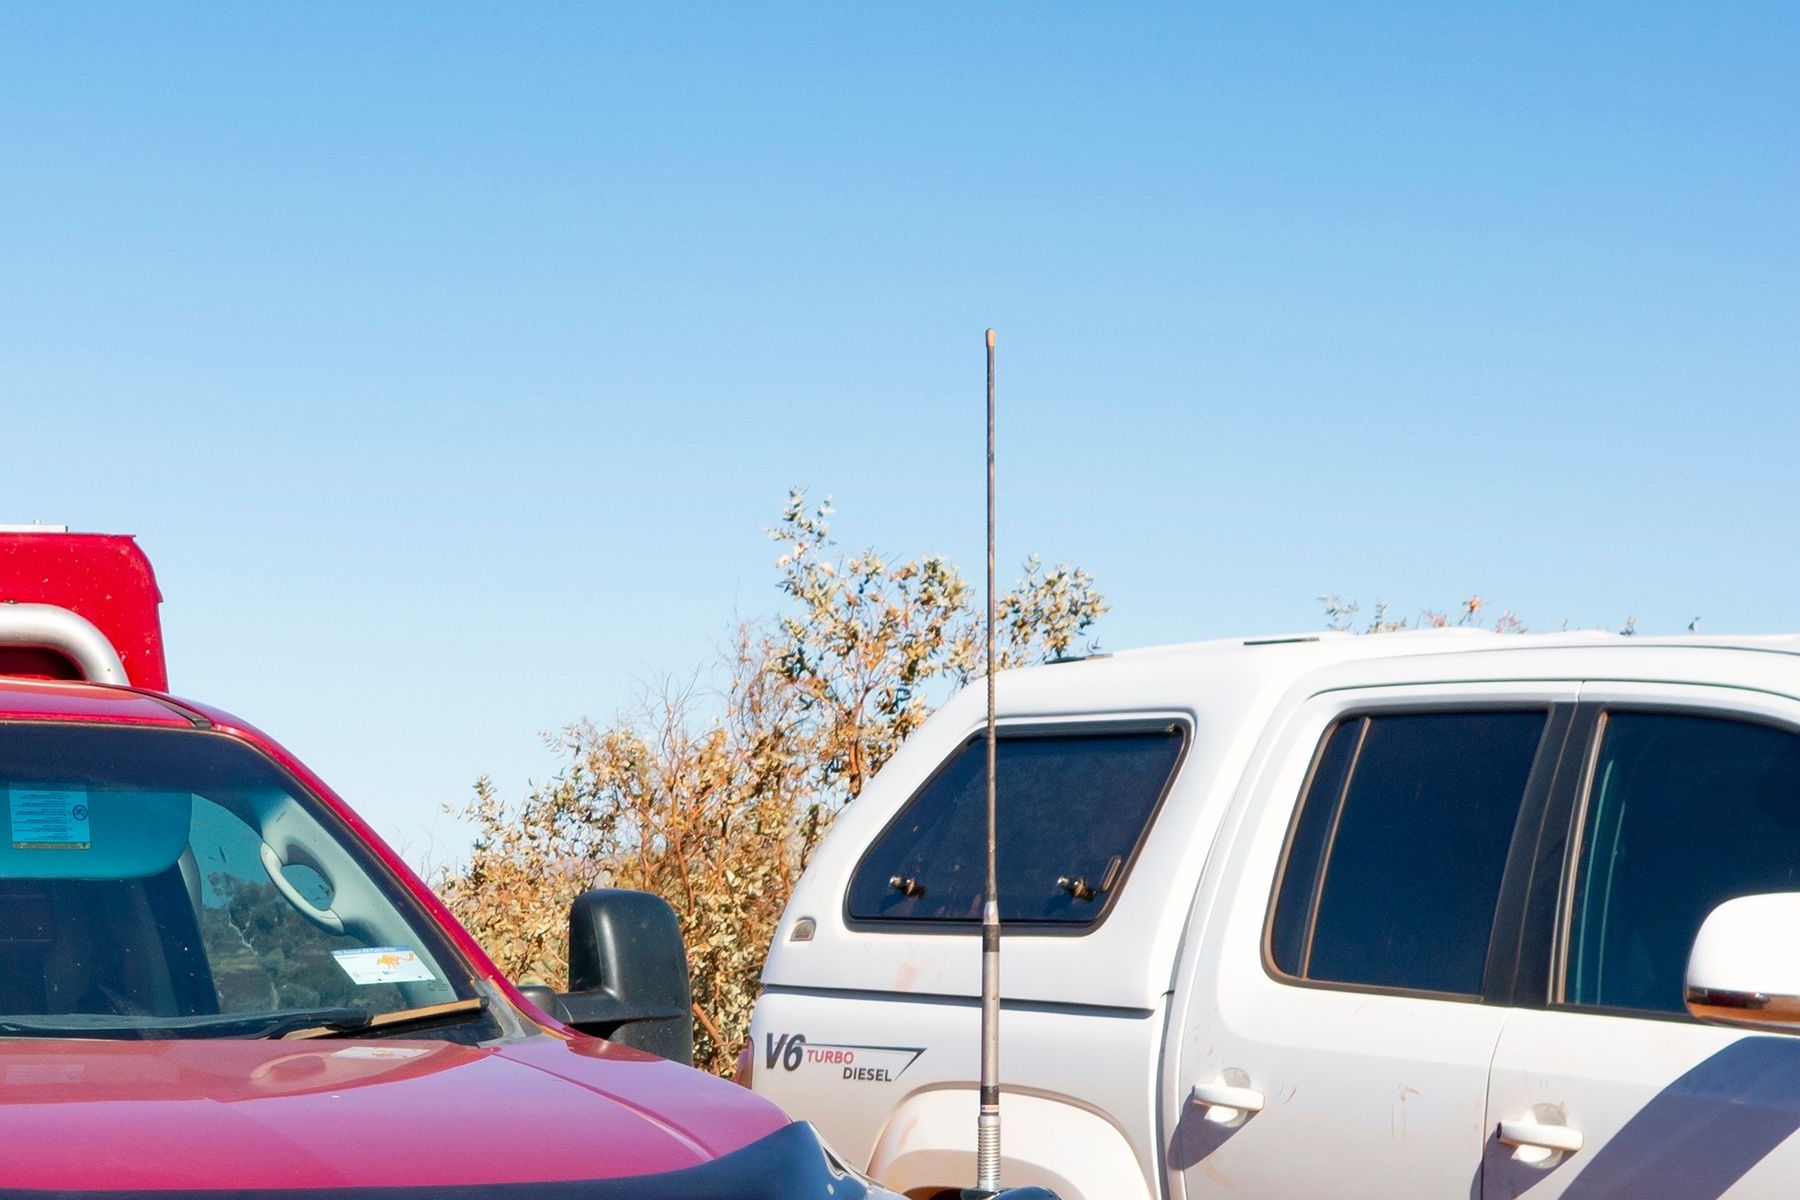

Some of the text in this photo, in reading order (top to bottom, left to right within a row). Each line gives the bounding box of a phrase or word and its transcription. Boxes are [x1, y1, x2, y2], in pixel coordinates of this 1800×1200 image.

[766, 1032, 854, 1071] V6 TURBO
[843, 1067, 892, 1082] DIESEL
